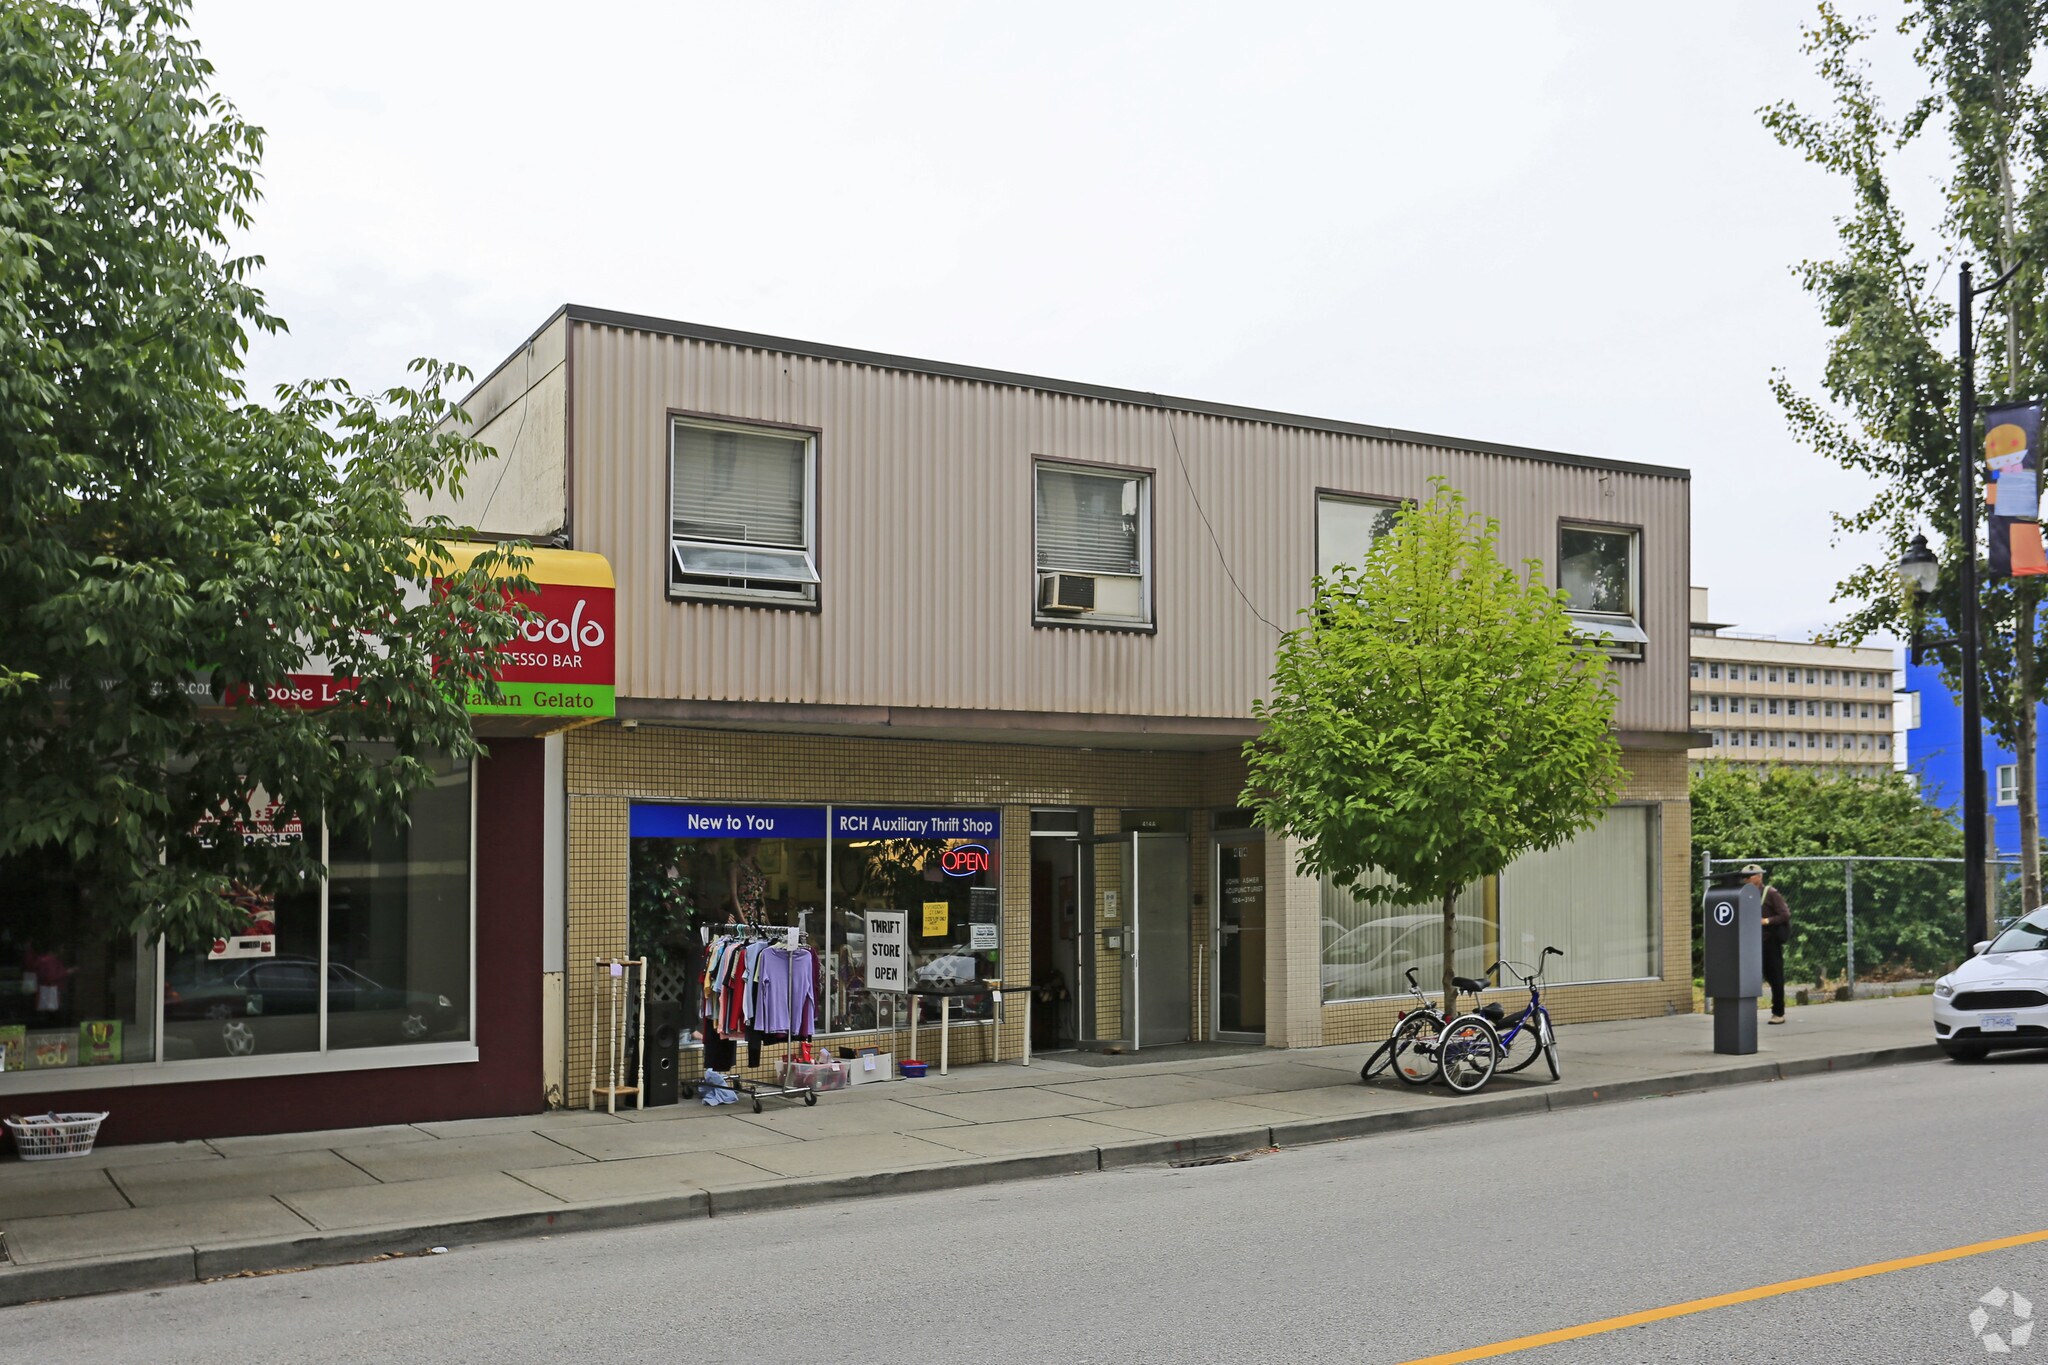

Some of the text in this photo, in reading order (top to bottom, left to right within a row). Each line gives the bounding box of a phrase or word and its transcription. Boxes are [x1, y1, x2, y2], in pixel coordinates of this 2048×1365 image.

[553, 654, 583, 668] BAR
[249, 682, 314, 701] oose
[534, 691, 594, 709] Gelato
[687, 813, 774, 831] New to You
[840, 815, 993, 836] RCH Auxiliary Thrift Shop
[942, 851, 989, 871] OPEN
[870, 919, 901, 934] THRIFT
[872, 943, 900, 958] STORE
[875, 967, 898, 981] OPEN
